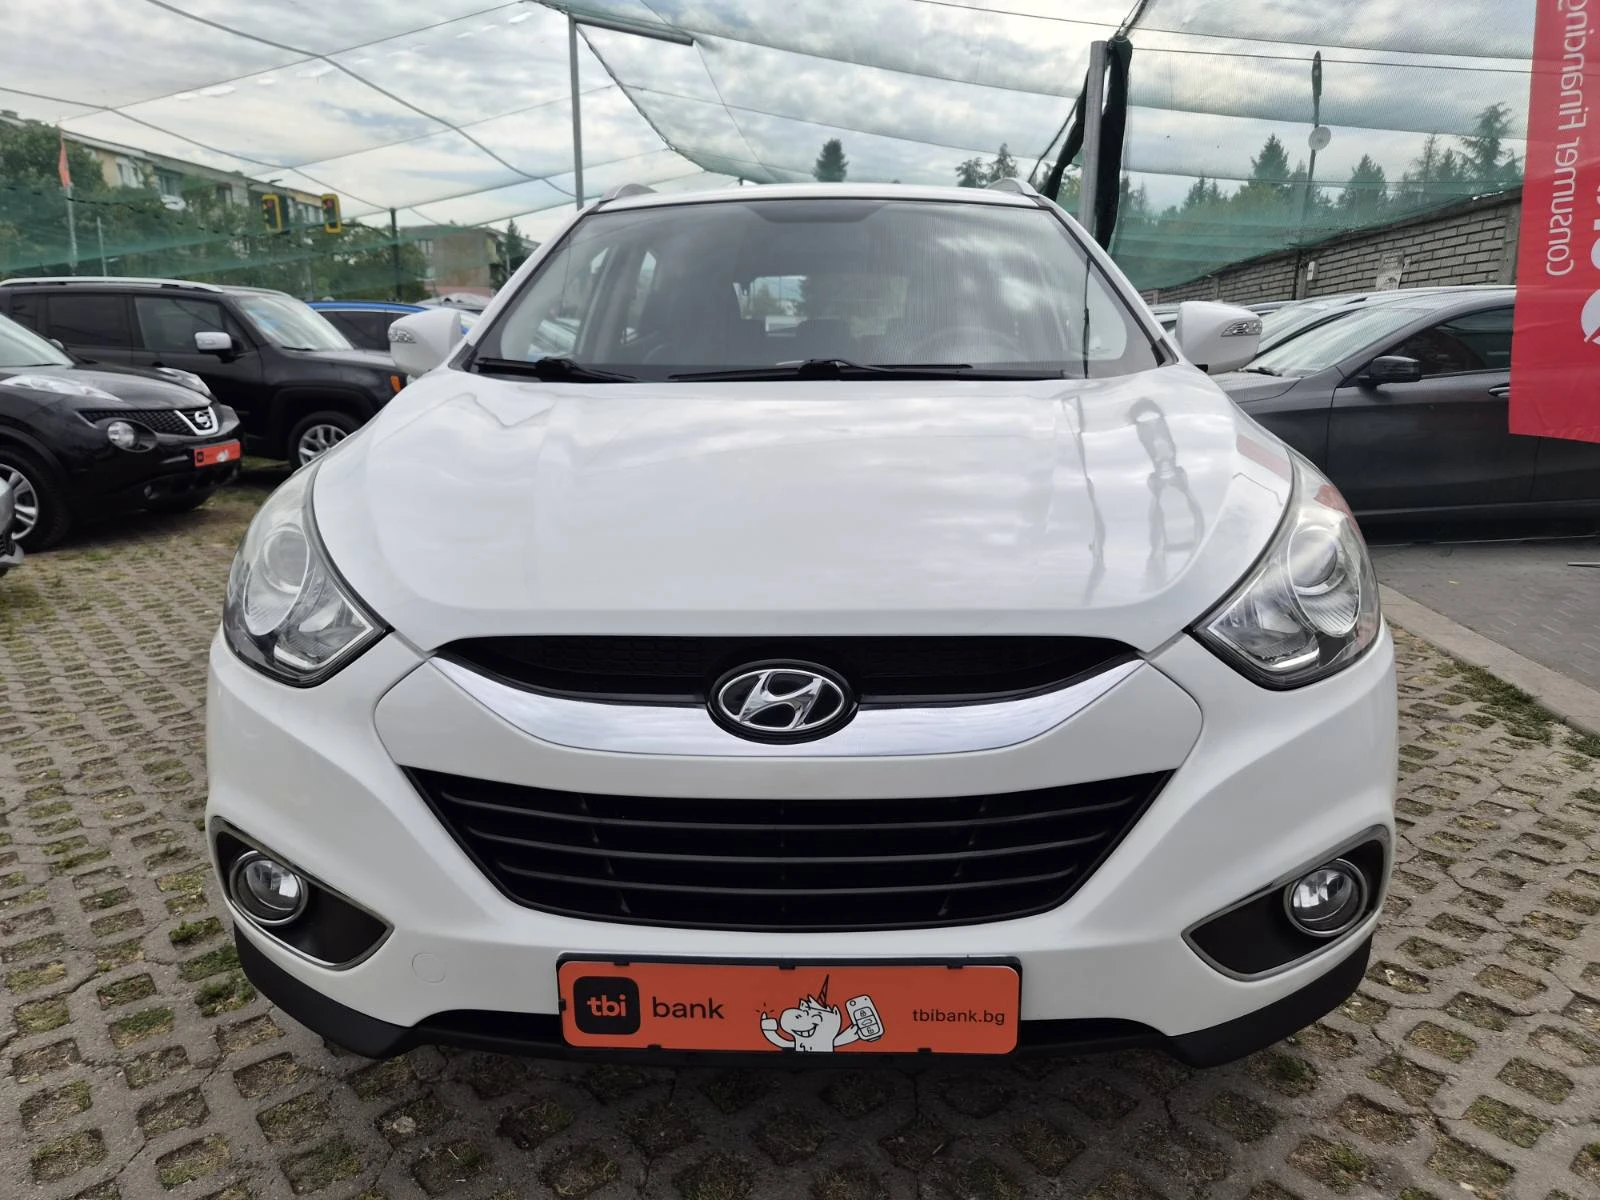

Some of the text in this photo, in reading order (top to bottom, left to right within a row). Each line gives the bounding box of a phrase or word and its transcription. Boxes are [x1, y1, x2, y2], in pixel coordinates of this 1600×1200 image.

[587, 994, 724, 1019] tbi bank
[912, 1008, 1005, 1026] tbibank.bg
